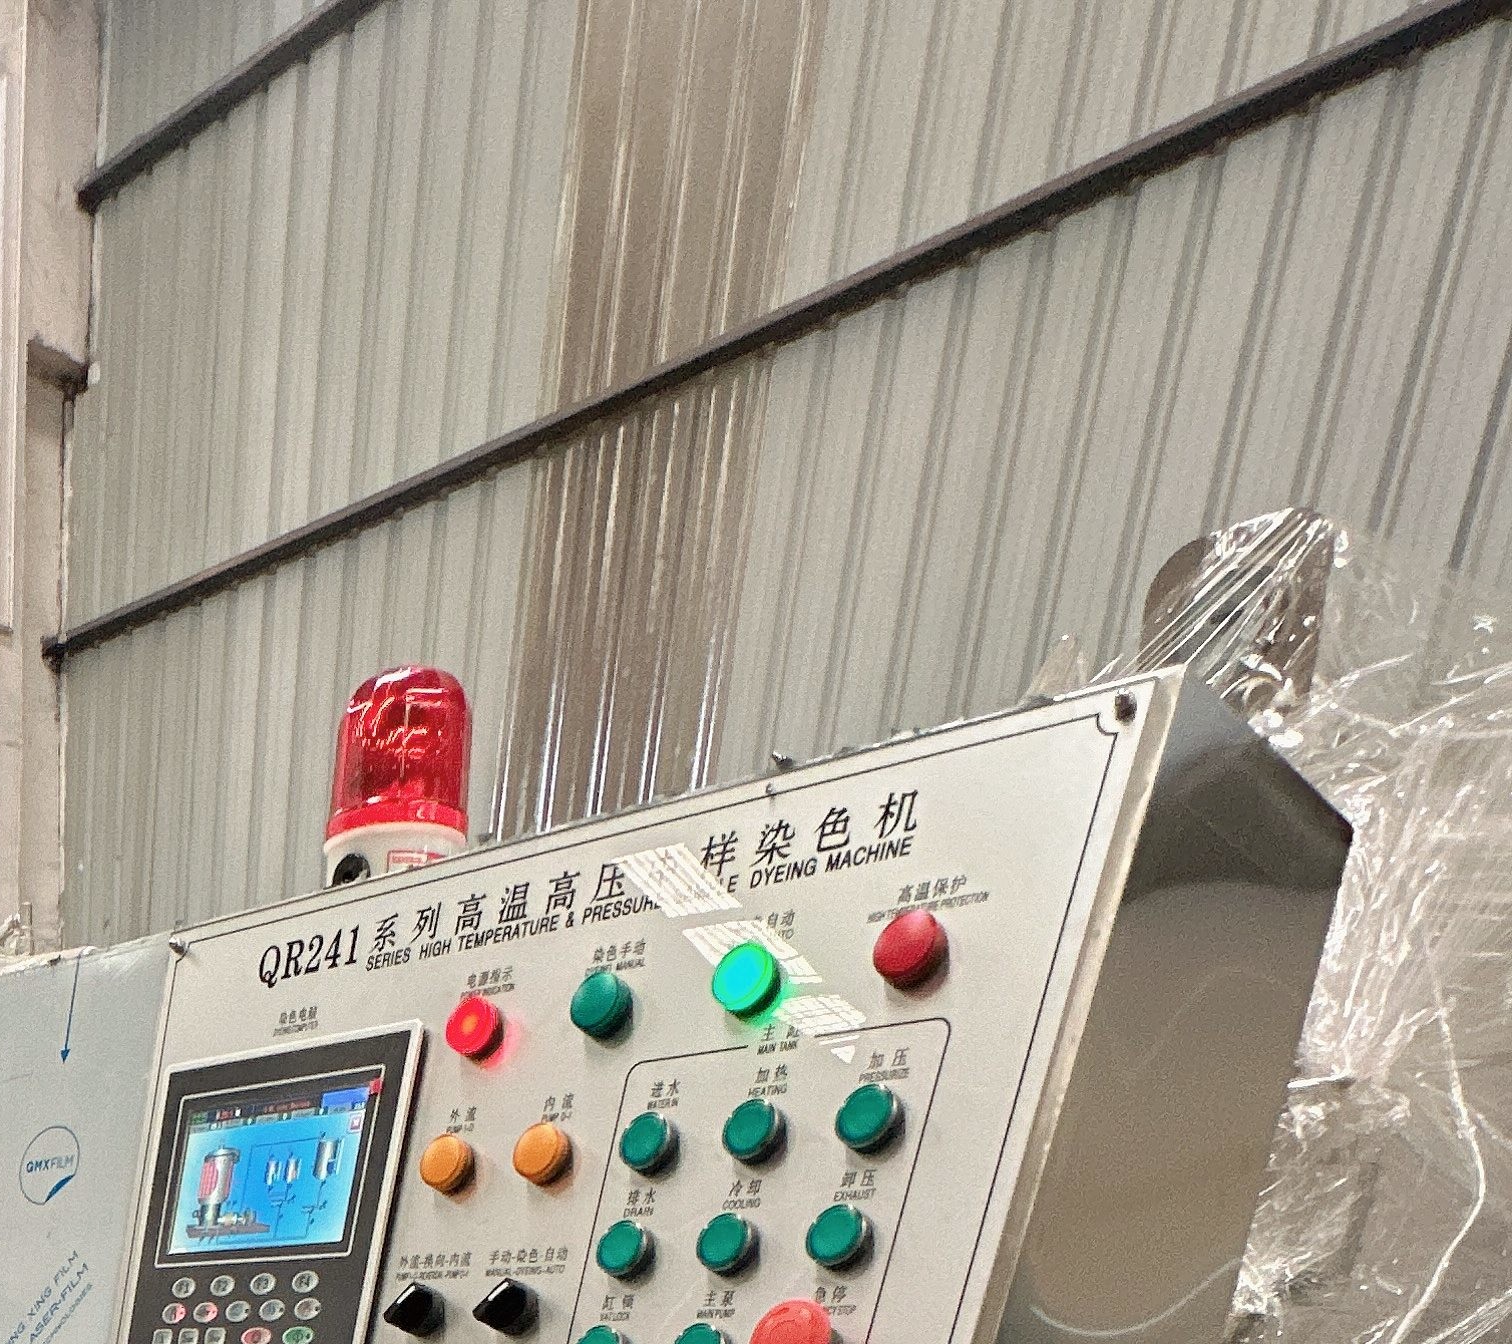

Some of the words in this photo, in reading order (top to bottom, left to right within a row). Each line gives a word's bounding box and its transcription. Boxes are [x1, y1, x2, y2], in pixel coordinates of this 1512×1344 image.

[259, 924, 358, 988] QR241
[370, 790, 918, 953] 系列高温高压样染色机
[898, 874, 968, 903] 高温保护
[366, 949, 410, 972] SERIES
[419, 939, 452, 961] HIGH
[458, 914, 559, 951] TEMPERATURE
[566, 910, 575, 928] &
[749, 858, 818, 890] DYEING
[825, 835, 915, 872] MACHINE
[867, 1047, 910, 1071] 加压
[754, 1064, 788, 1084] 加热
[728, 1179, 761, 1198] 冷却
[834, 1187, 877, 1202] EXHAUST
[722, 1198, 761, 1211] COOLING
